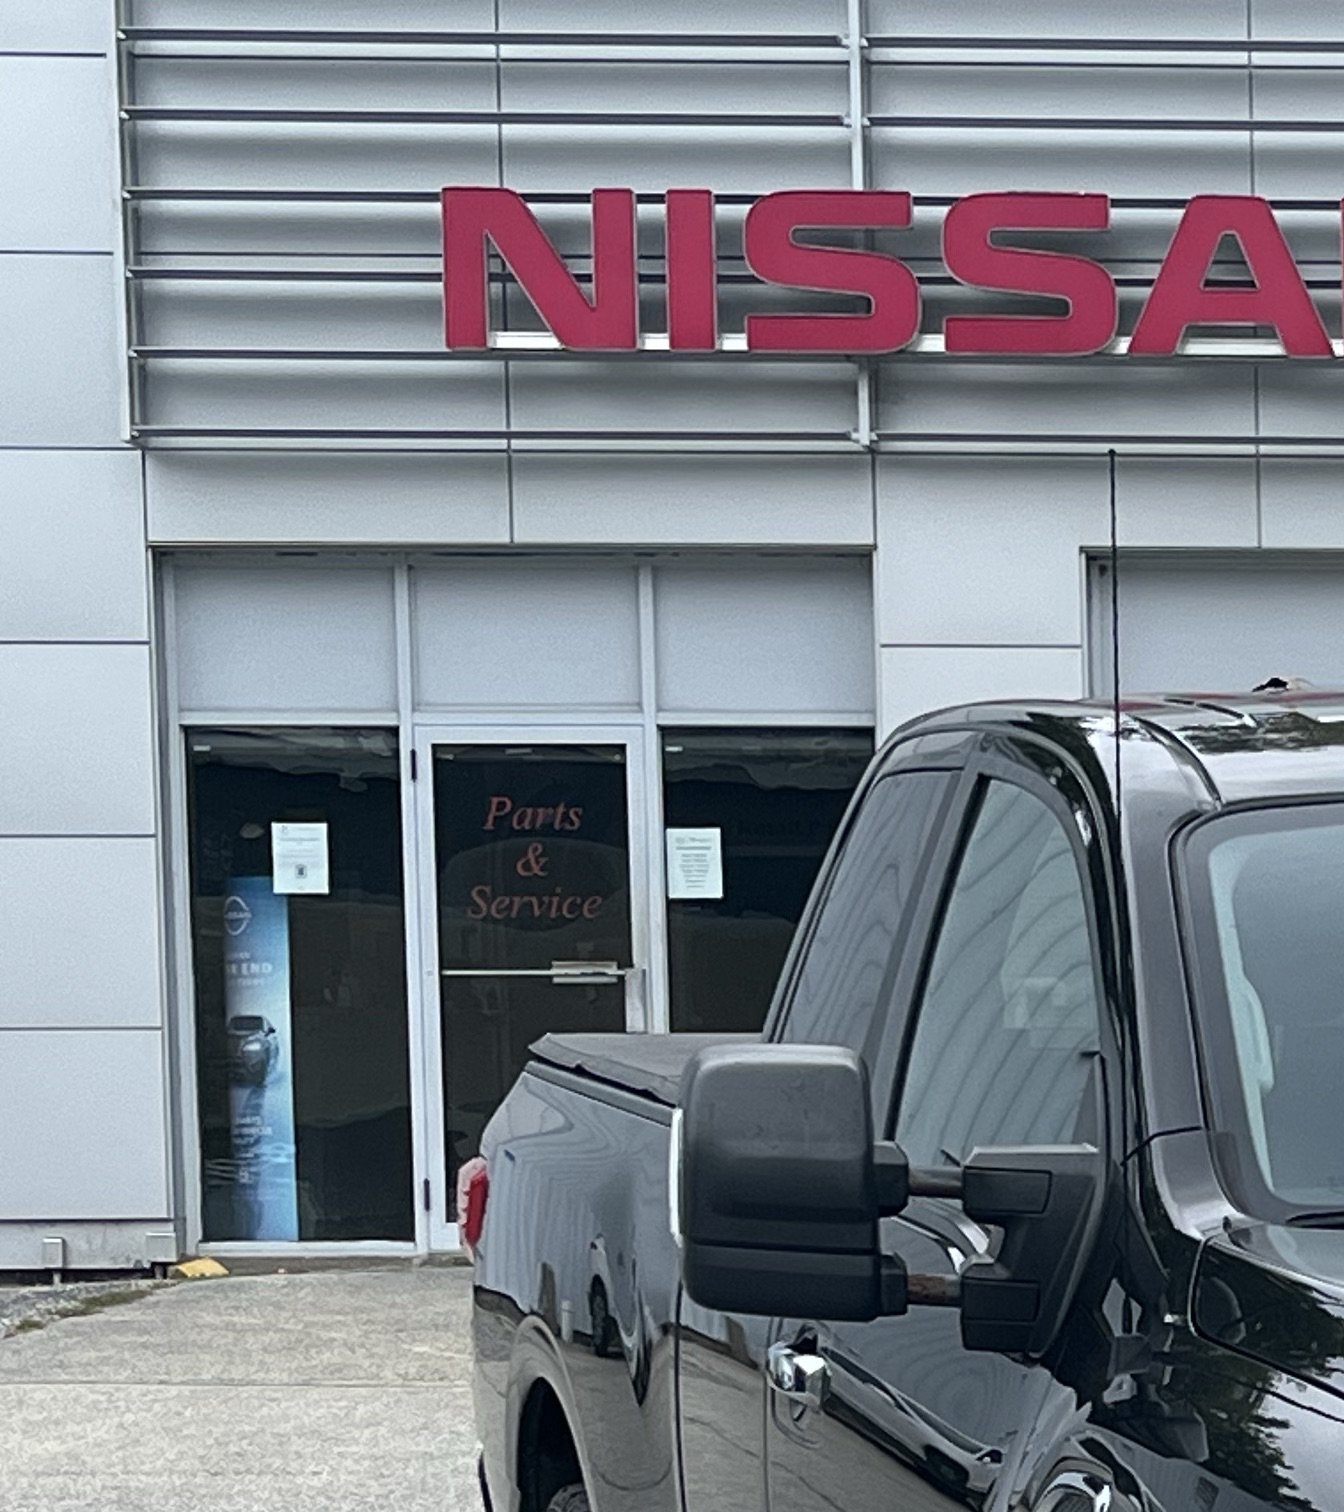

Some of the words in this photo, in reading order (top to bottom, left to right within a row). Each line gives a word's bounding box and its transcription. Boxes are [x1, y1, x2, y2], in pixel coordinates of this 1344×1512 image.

[482, 796, 583, 831] Parts
[516, 843, 549, 876] &
[467, 885, 603, 919] Service
